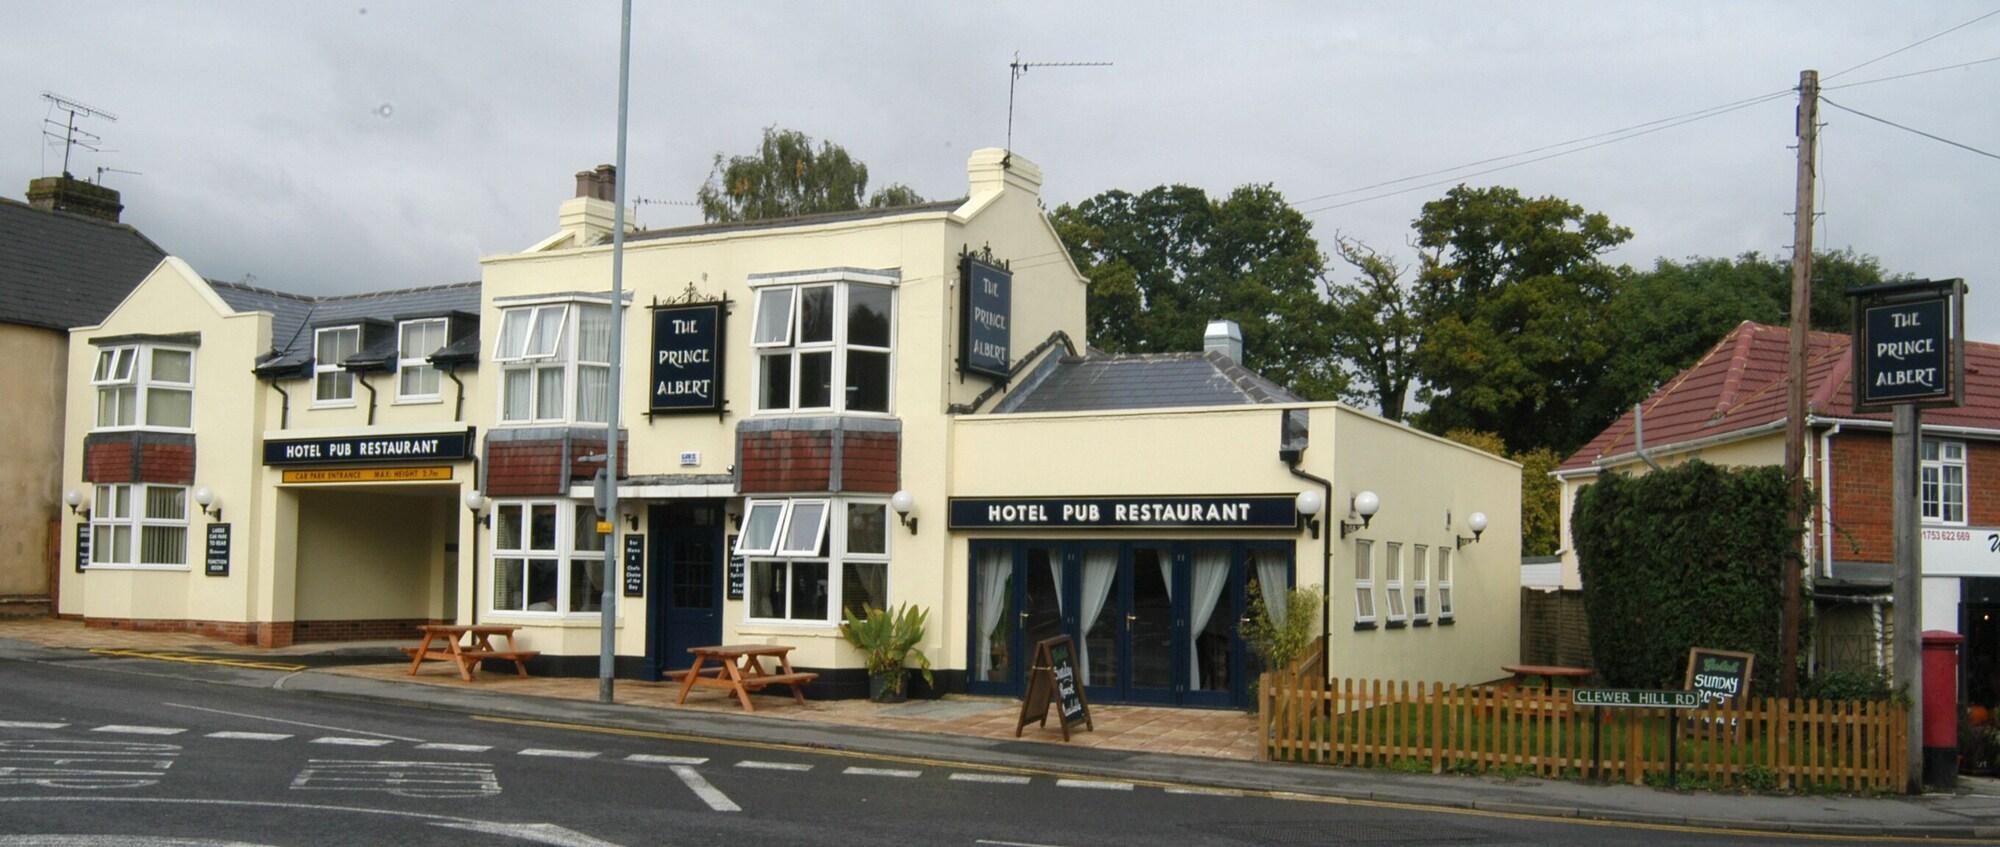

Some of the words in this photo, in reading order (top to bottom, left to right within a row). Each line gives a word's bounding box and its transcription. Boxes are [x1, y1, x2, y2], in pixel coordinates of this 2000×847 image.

[983, 278, 1000, 298] THE
[672, 319, 698, 334] THE
[974, 306, 1006, 330] PRINCE
[1891, 312, 1921, 328] THE
[659, 349, 710, 368] PRINCE
[973, 339, 1007, 366] ALBERT
[1877, 338, 1935, 360] PRINCE
[1876, 367, 1937, 387] ALBERT
[657, 379, 711, 398] ALBERT
[286, 444, 322, 458] HOTEL
[329, 442, 352, 456] PUB
[359, 439, 439, 455] RESTAURANT
[310, 472, 326, 480] PARK
[328, 470, 361, 479] ENTRANCE
[394, 469, 418, 477] HEIGHT
[988, 505, 1048, 521] HOTEL
[1063, 505, 1102, 521] PUB
[1115, 503, 1250, 521] RESTAURANT
[1921, 530, 1941, 541] 1753
[1942, 531, 1956, 541] 622
[1577, 690, 1631, 703] CLEWER
[1639, 692, 1668, 704] HILL
[1675, 693, 1695, 705] RD
